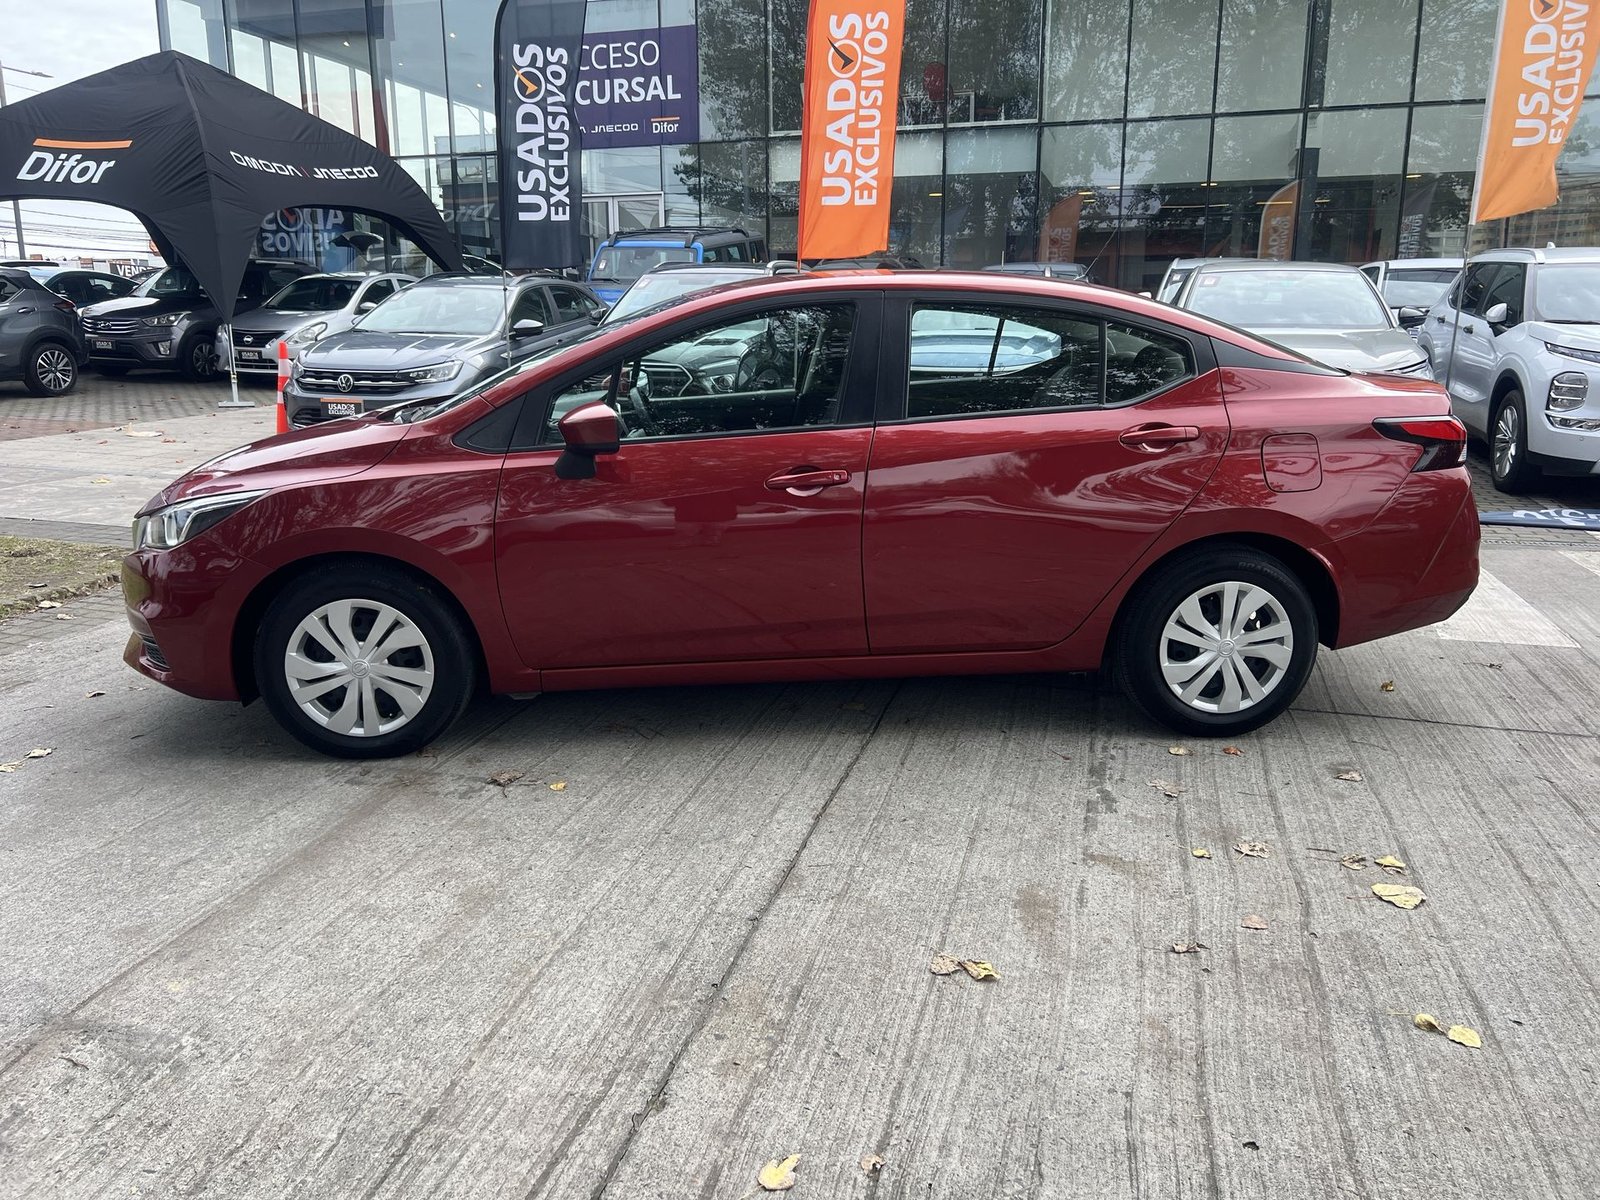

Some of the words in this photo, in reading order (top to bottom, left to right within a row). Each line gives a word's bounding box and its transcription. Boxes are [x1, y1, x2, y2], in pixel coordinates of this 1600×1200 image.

[575, 74, 682, 105] CURSAL
[579, 40, 660, 71] CCESO
[1512, 0, 1564, 147] USADO
[1548, 0, 1589, 144] EXCLUSIV
[512, 43, 548, 221] USADOS
[546, 46, 570, 221] EXCLUSIVOS
[591, 123, 639, 133] JAECOO
[652, 121, 679, 134] Difor
[821, 13, 863, 206] USADOS
[854, 11, 889, 206] EXCLUSIVOS
[16, 151, 116, 184] Difor
[230, 150, 302, 177] OMODA
[313, 165, 379, 180] JAECOO
[328, 403, 356, 411] USADOS
